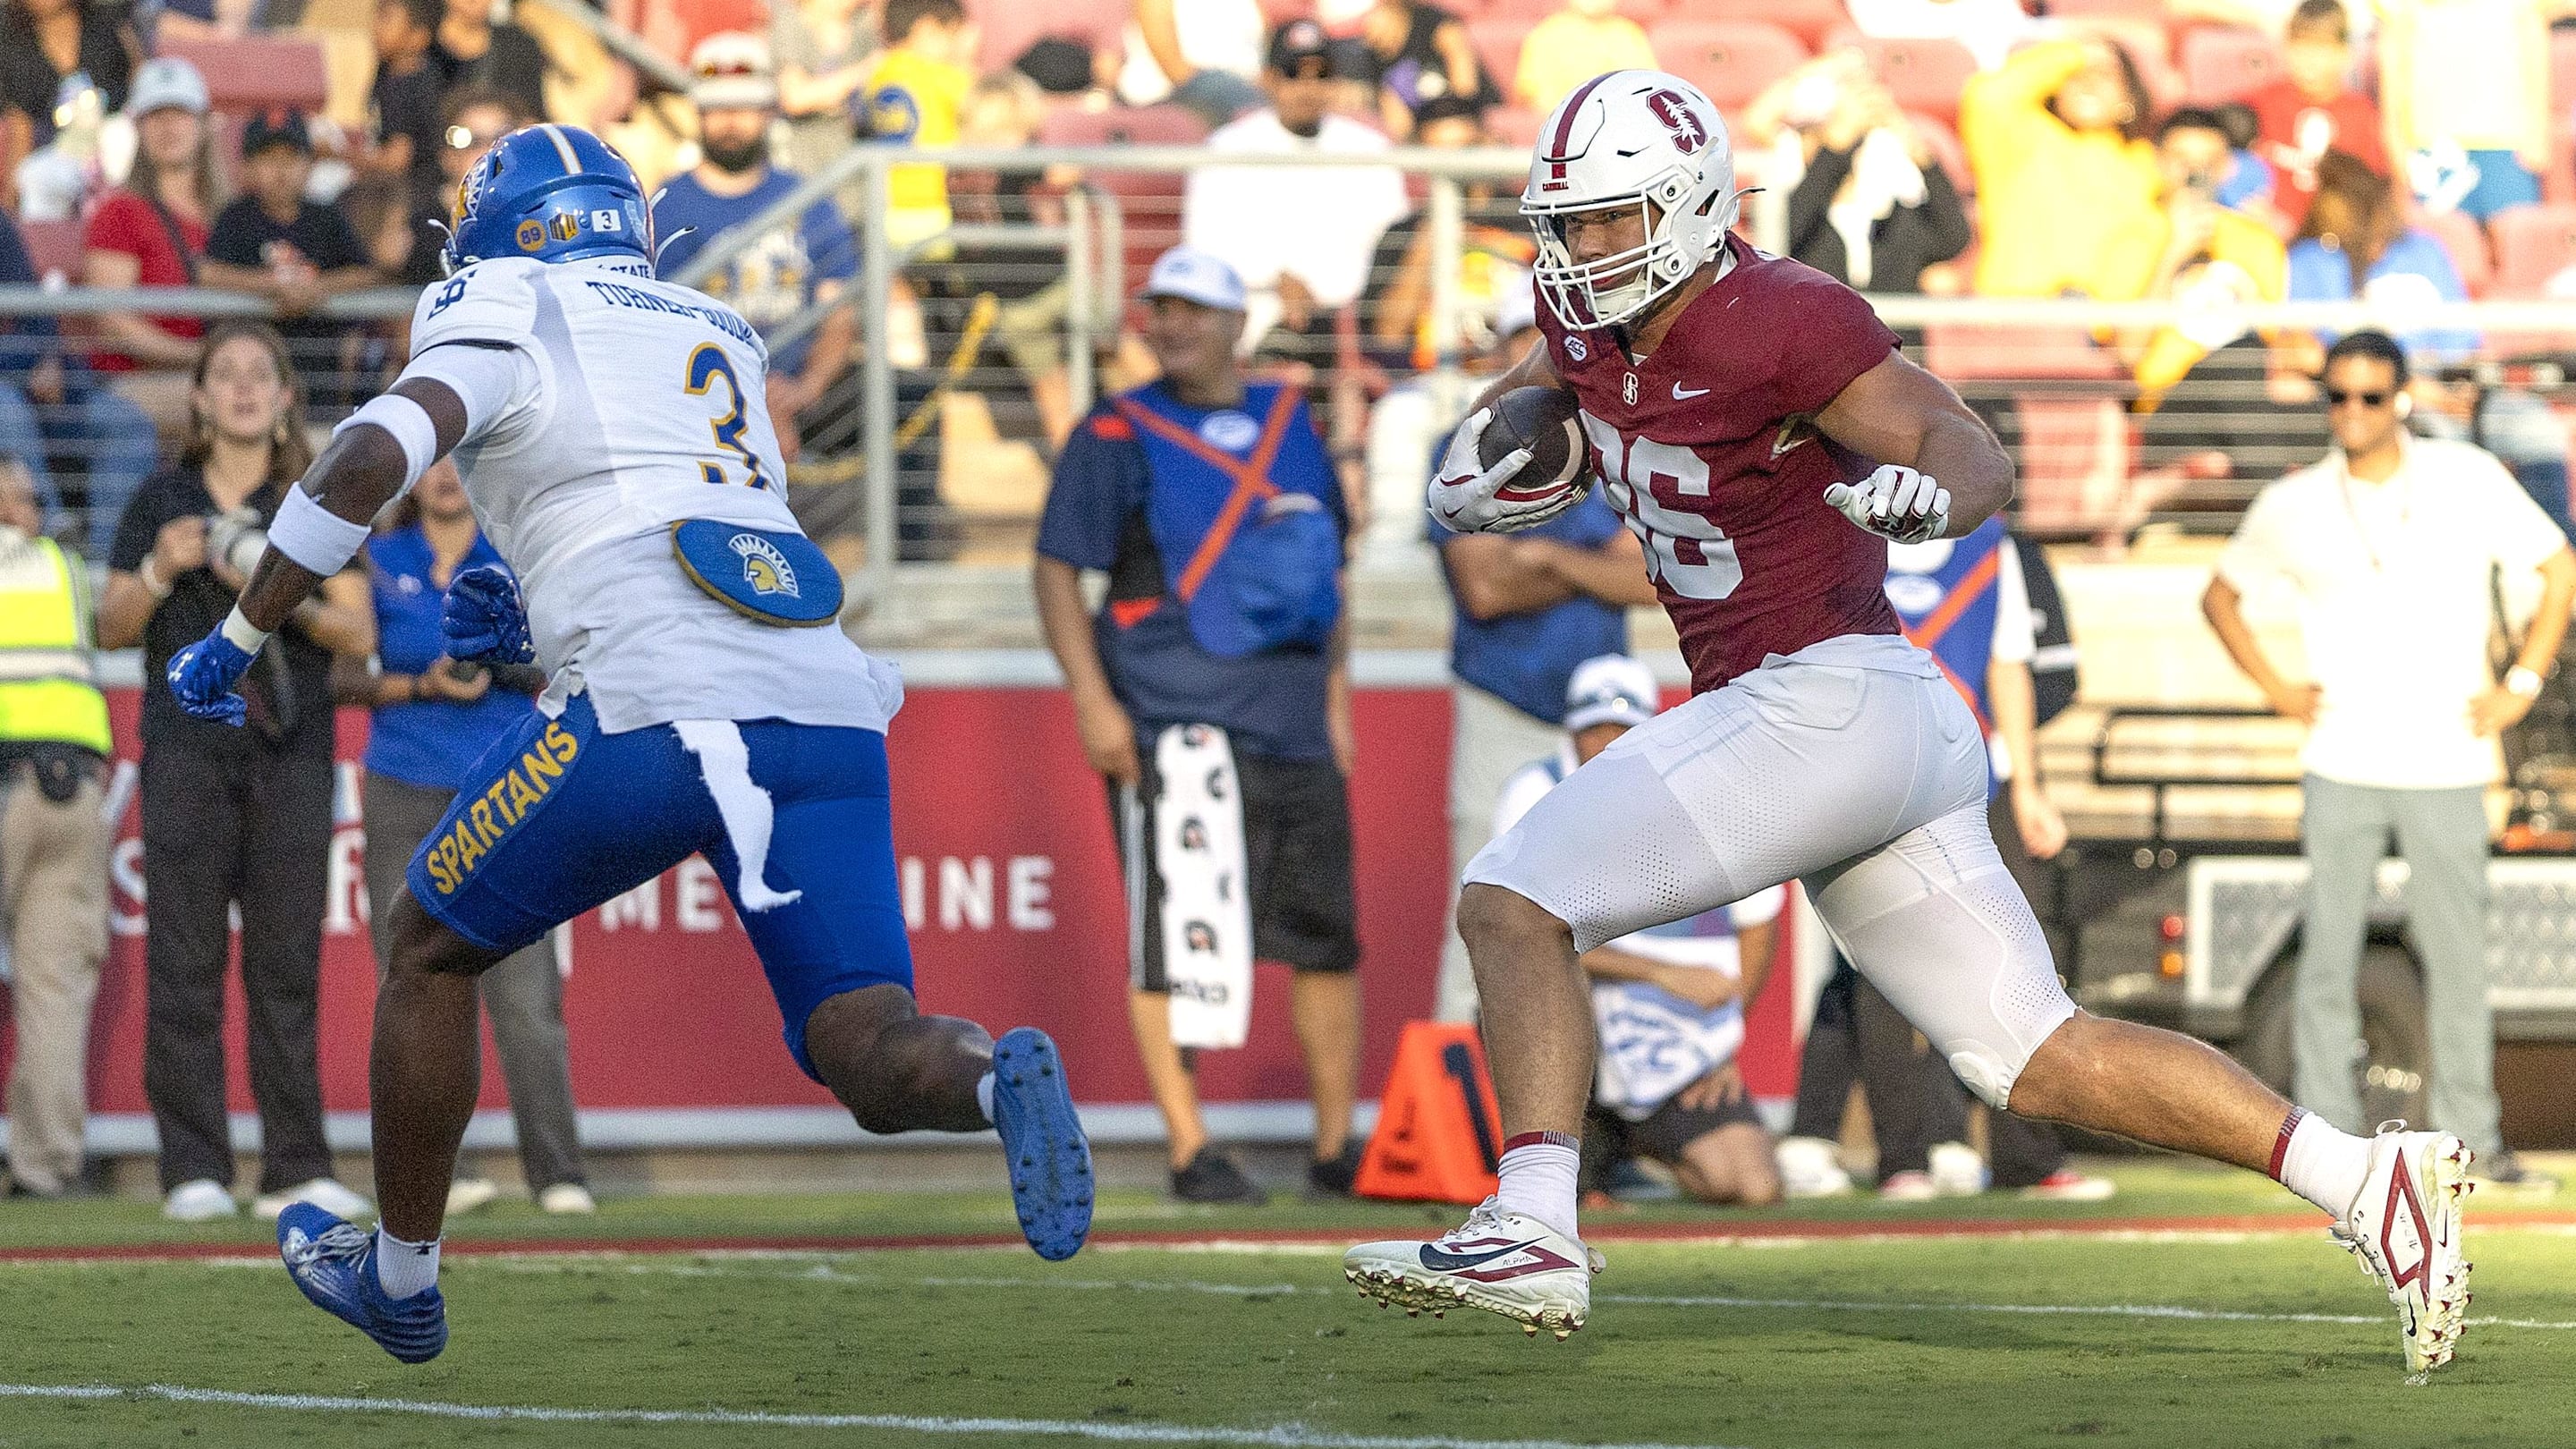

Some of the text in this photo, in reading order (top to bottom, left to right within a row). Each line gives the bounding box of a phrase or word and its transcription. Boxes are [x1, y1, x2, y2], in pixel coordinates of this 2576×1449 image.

[601, 211, 612, 230] 3
[521, 226, 542, 244] 89
[610, 265, 649, 278] TATE
[1567, 340, 1585, 354] ACC
[684, 341, 769, 491] 3
[427, 722, 578, 894] SPARTANS
[598, 855, 1055, 932] MEINE
